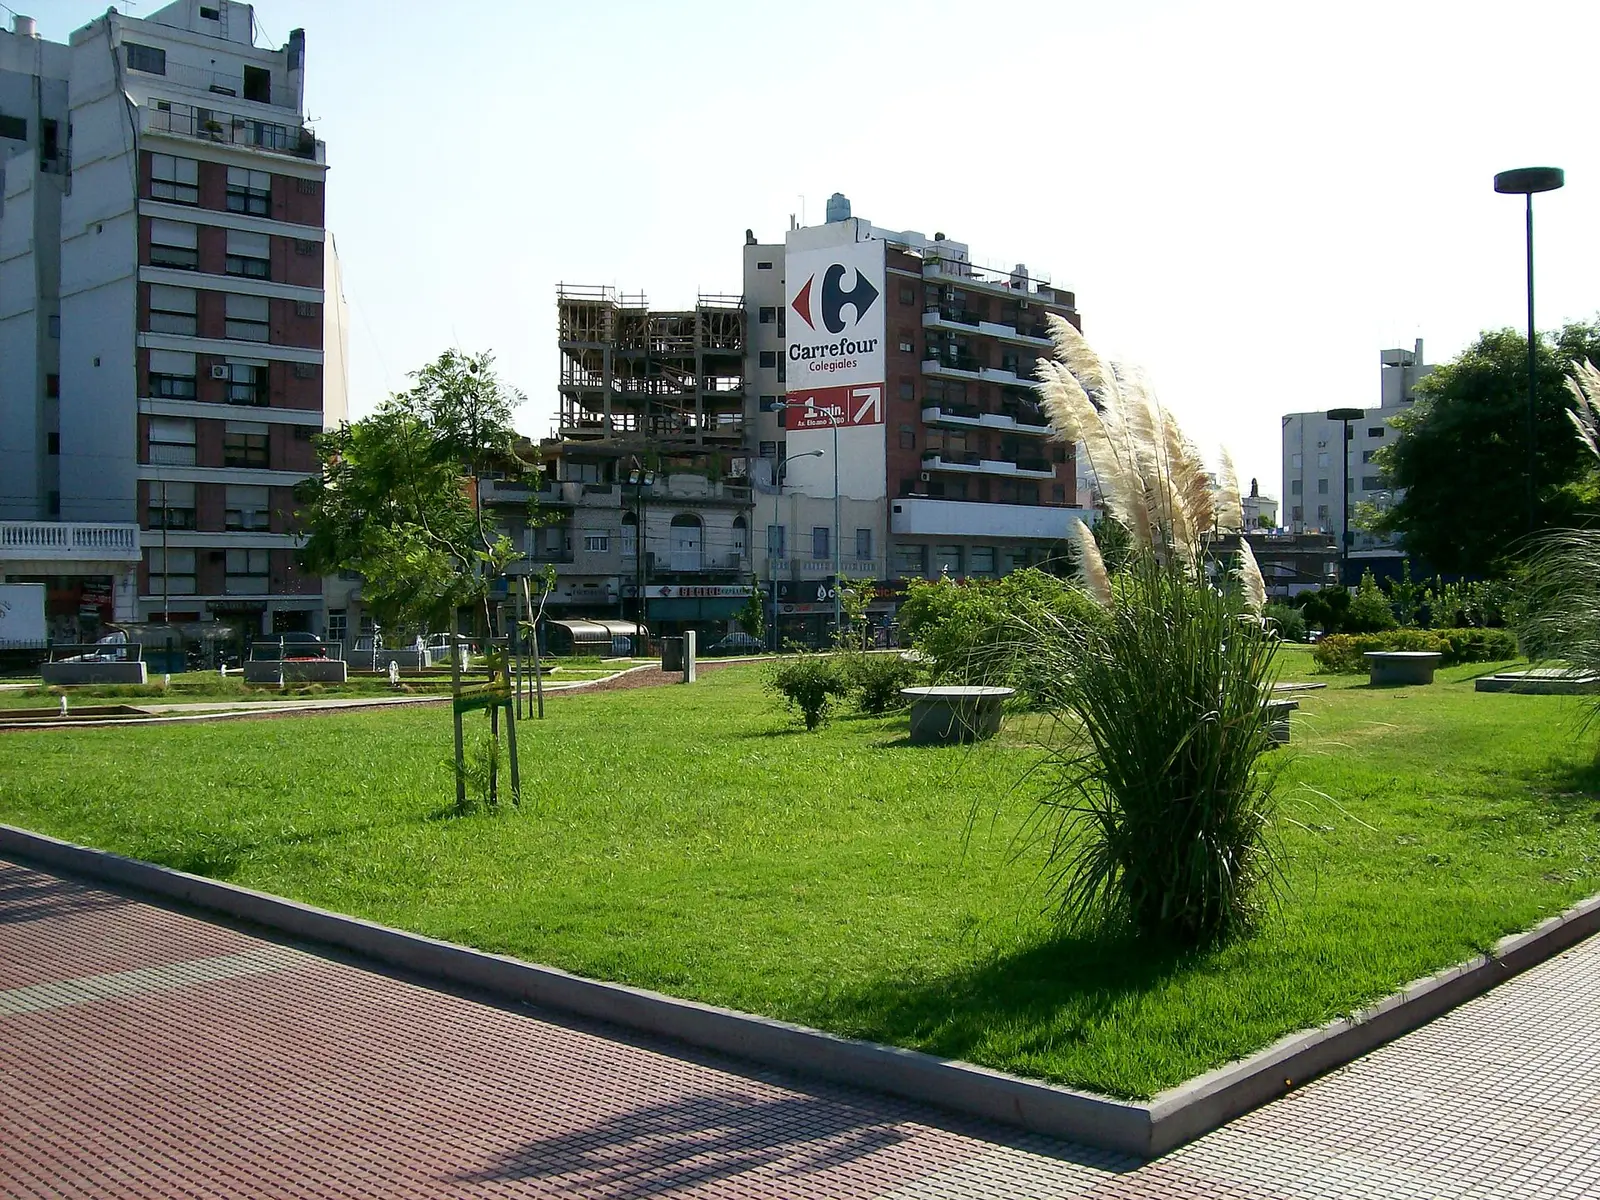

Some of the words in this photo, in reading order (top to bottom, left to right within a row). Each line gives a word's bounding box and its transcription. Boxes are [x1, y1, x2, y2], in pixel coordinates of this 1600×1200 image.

[789, 338, 878, 361] Carrefour
[809, 360, 857, 372] Colegiales
[804, 397, 817, 418] 1
